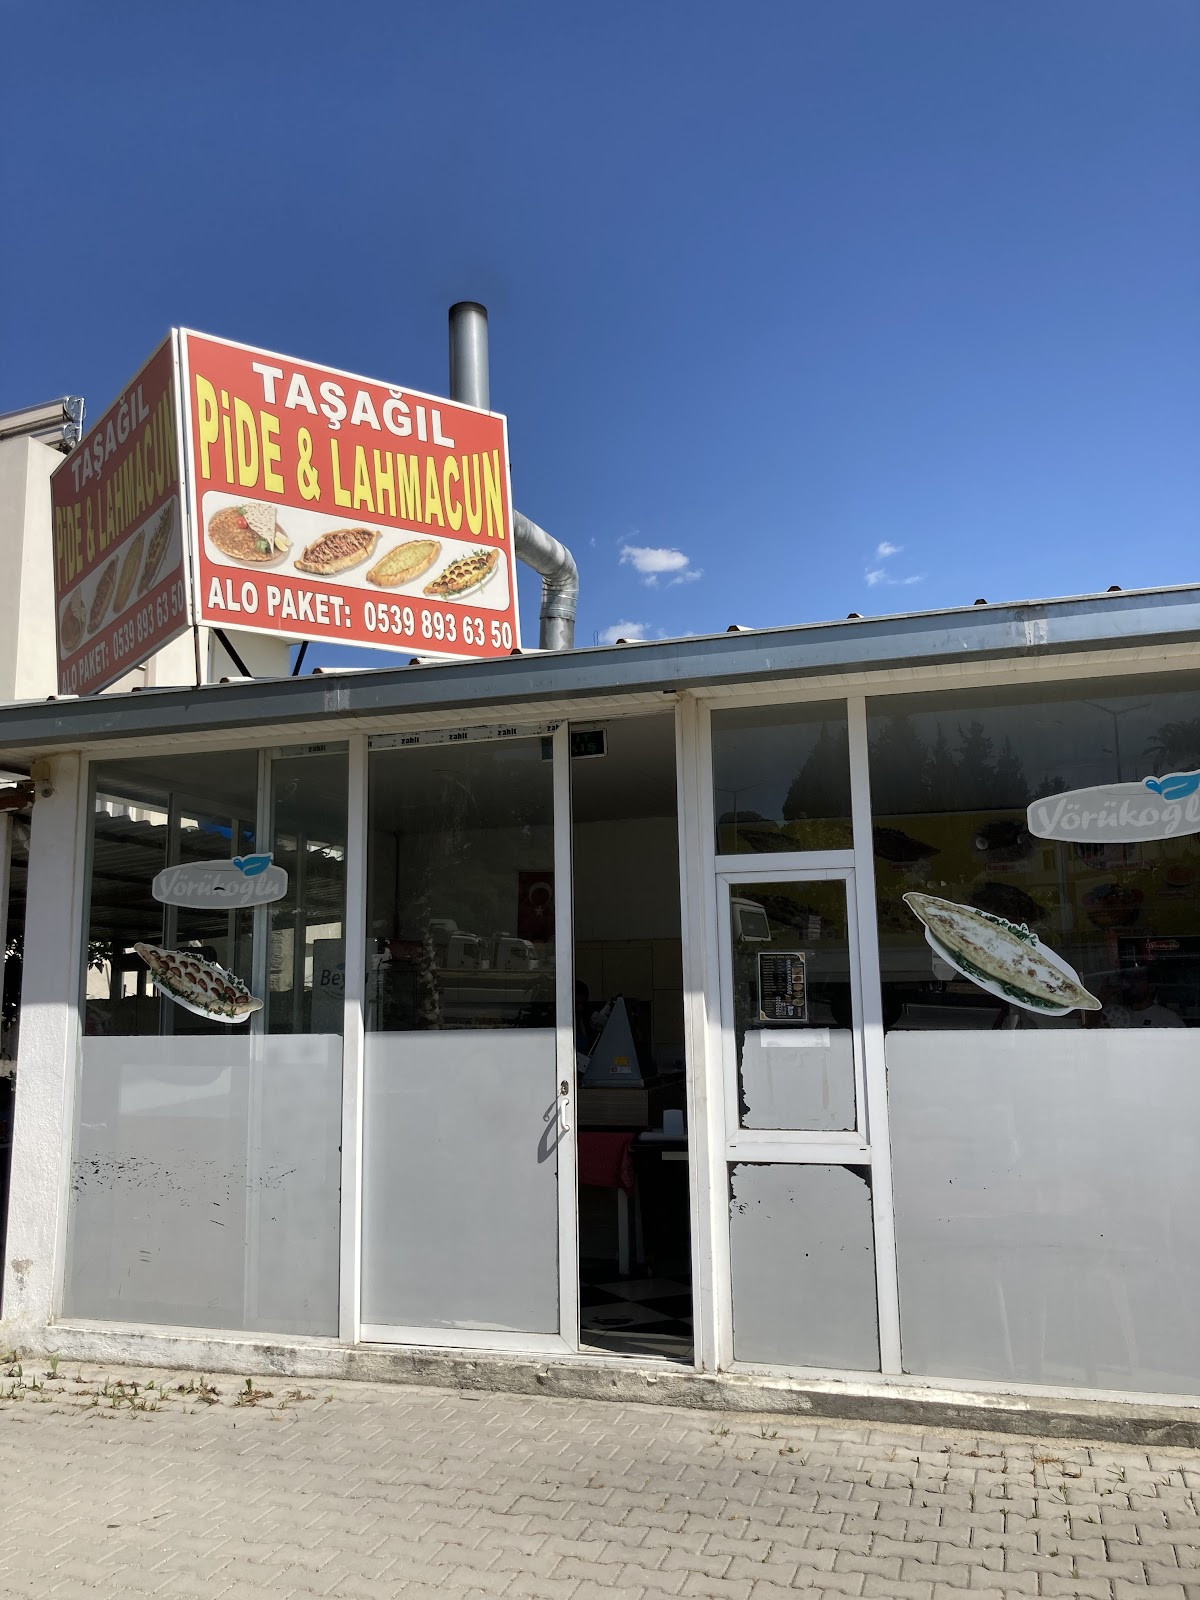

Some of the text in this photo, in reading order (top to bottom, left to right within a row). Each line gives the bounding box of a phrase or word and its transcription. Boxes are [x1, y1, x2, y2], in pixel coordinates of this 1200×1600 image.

[71, 383, 149, 493] TAŞAĞIL
[252, 361, 455, 449] TAŞAĞIL
[86, 495, 96, 564] &
[97, 376, 177, 552] LAHMACUN
[296, 427, 321, 501] &
[330, 438, 505, 540] LAHMACUN
[61, 668, 77, 695] ALO
[113, 620, 136, 661] 0539
[137, 603, 154, 643] 893
[156, 591, 169, 628] 63
[171, 579, 185, 617] 50
[207, 576, 513, 650] ALO PAKET: 0539 893 63 50
